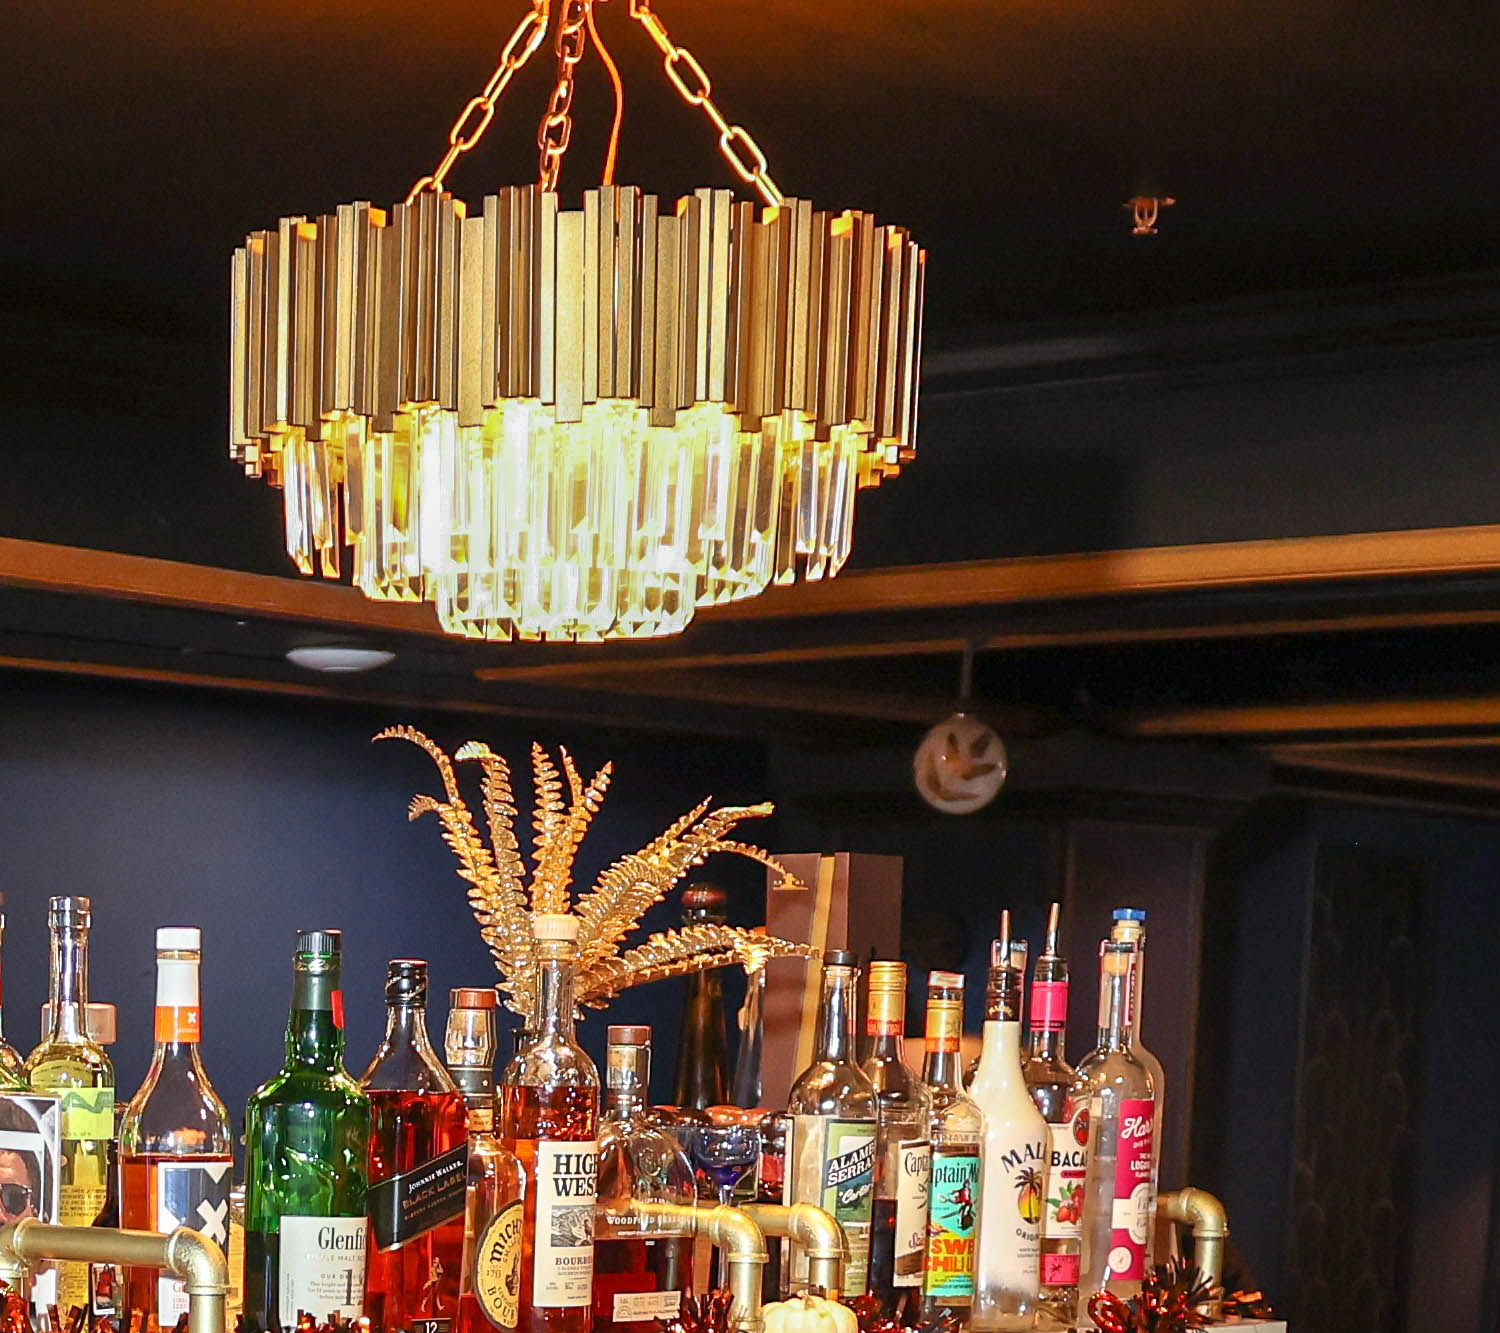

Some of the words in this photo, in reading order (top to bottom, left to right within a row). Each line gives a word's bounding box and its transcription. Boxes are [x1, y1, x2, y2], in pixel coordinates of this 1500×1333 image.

[828, 1142, 877, 1173] ALAME
[904, 1151, 929, 1176] Capt
[1001, 1141, 1047, 1174] MALI
[1051, 1151, 1088, 1167] BACA
[827, 1155, 875, 1186] SERRA
[934, 1162, 967, 1187] ptain
[402, 1187, 435, 1209] BLACK
[436, 1170, 467, 1193] LABEL
[408, 1173, 435, 1194] JOHNNIE
[606, 1215, 655, 1226] WOODFD
[489, 1217, 523, 1265] MICHT
[931, 1239, 975, 1254] SWE
[1016, 1228, 1040, 1241] ORIGI
